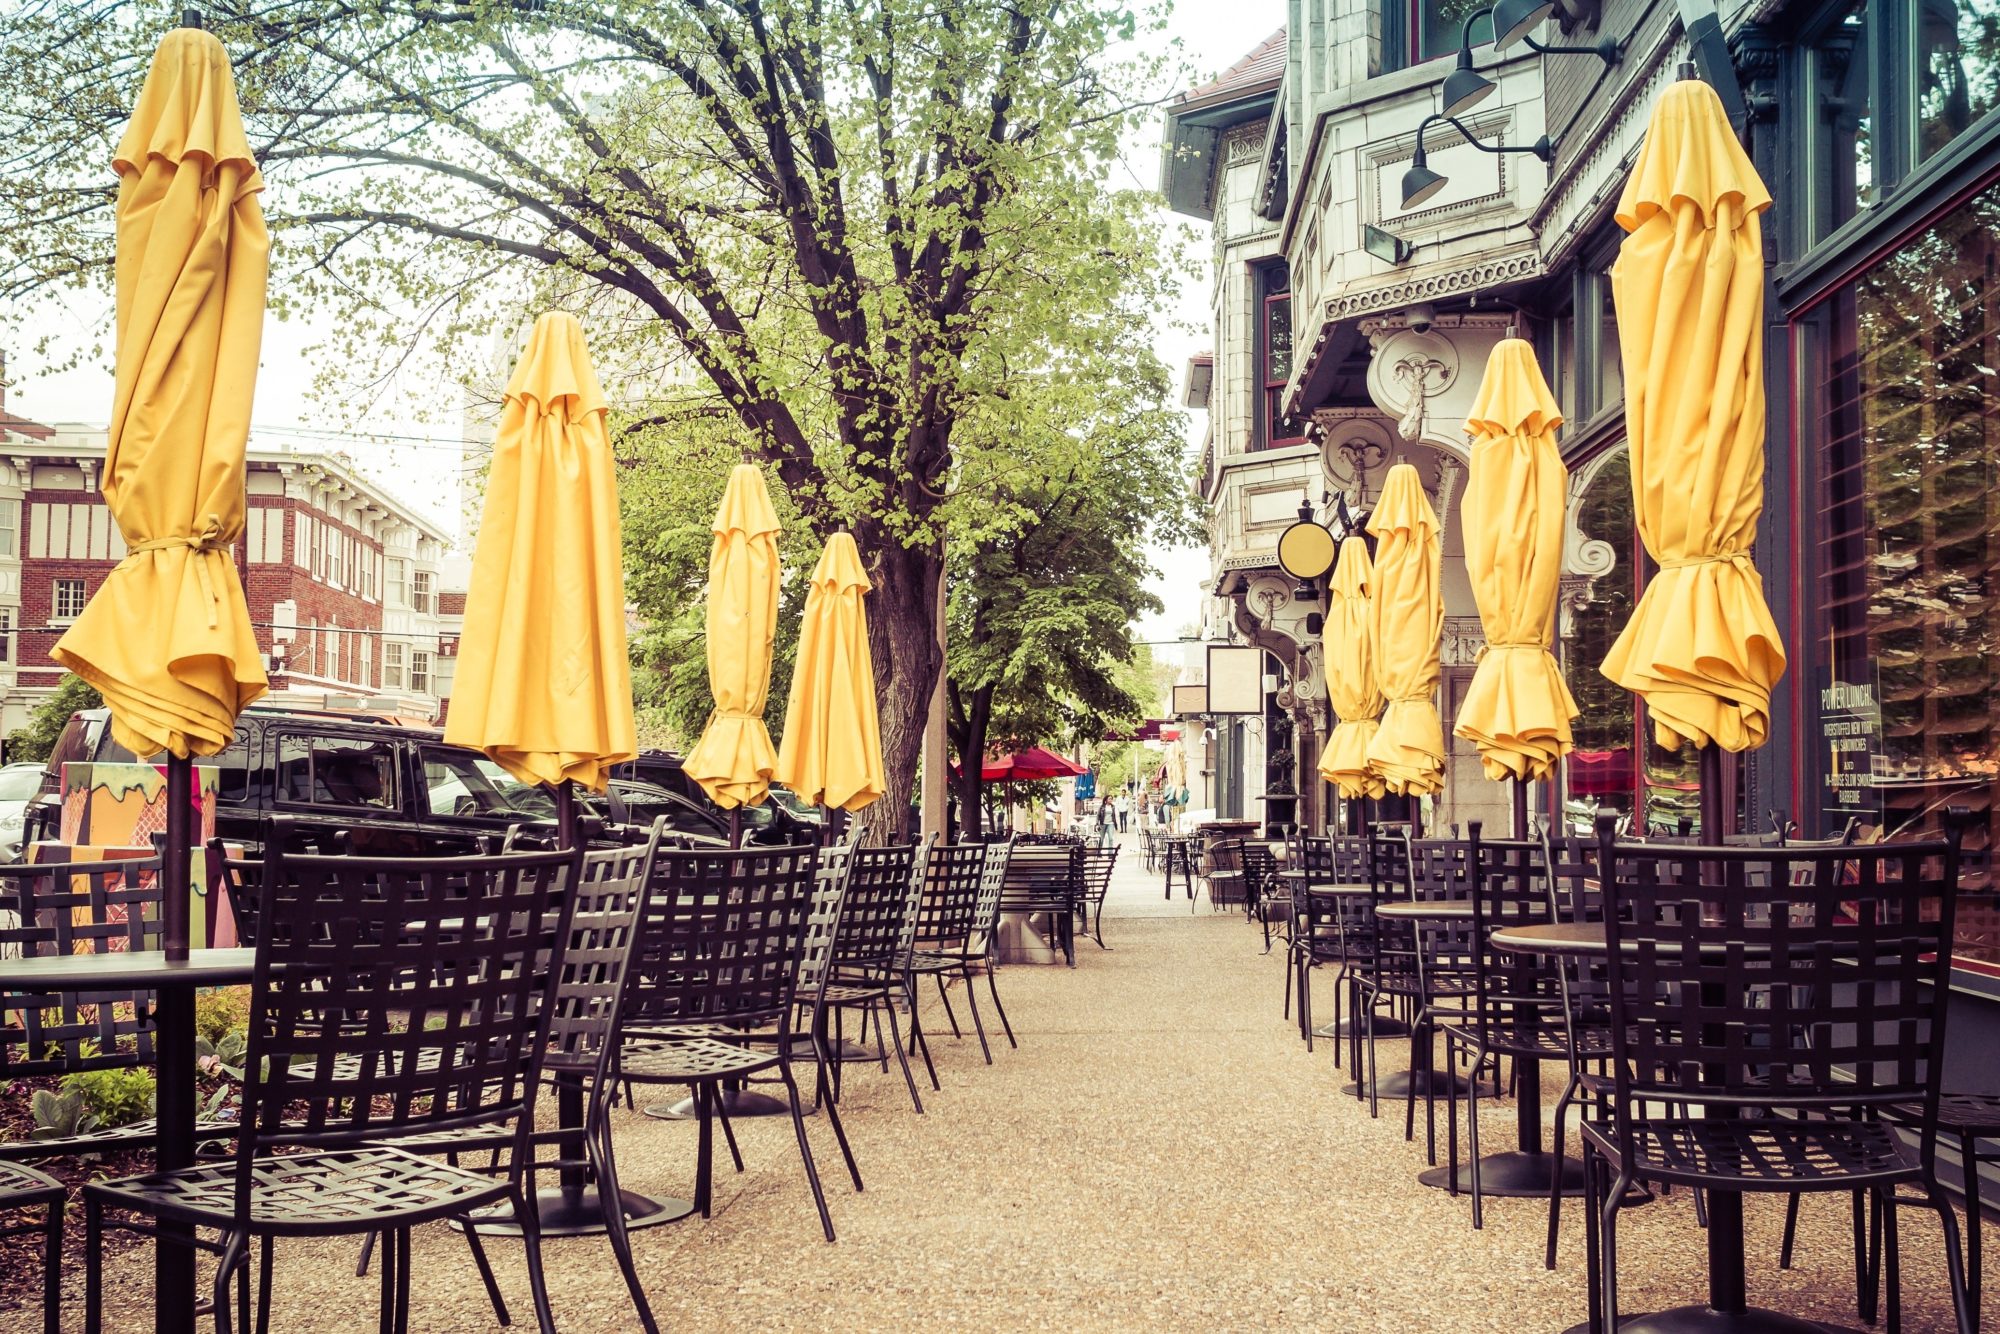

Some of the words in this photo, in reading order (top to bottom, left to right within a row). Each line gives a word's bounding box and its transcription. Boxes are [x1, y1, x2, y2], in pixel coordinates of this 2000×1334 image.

[1821, 688, 1845, 711] POWER
[1846, 683, 1873, 708] LUNCH!
[1823, 722, 1850, 737] OVERSTUFFED
[1850, 721, 1861, 735] NEW
[1861, 720, 1873, 734] YORK
[1840, 737, 1867, 753] SANDWICHES
[1843, 761, 1855, 771] AND
[1844, 773, 1857, 787] SLOW
[1839, 789, 1861, 804] BARBEQUE
